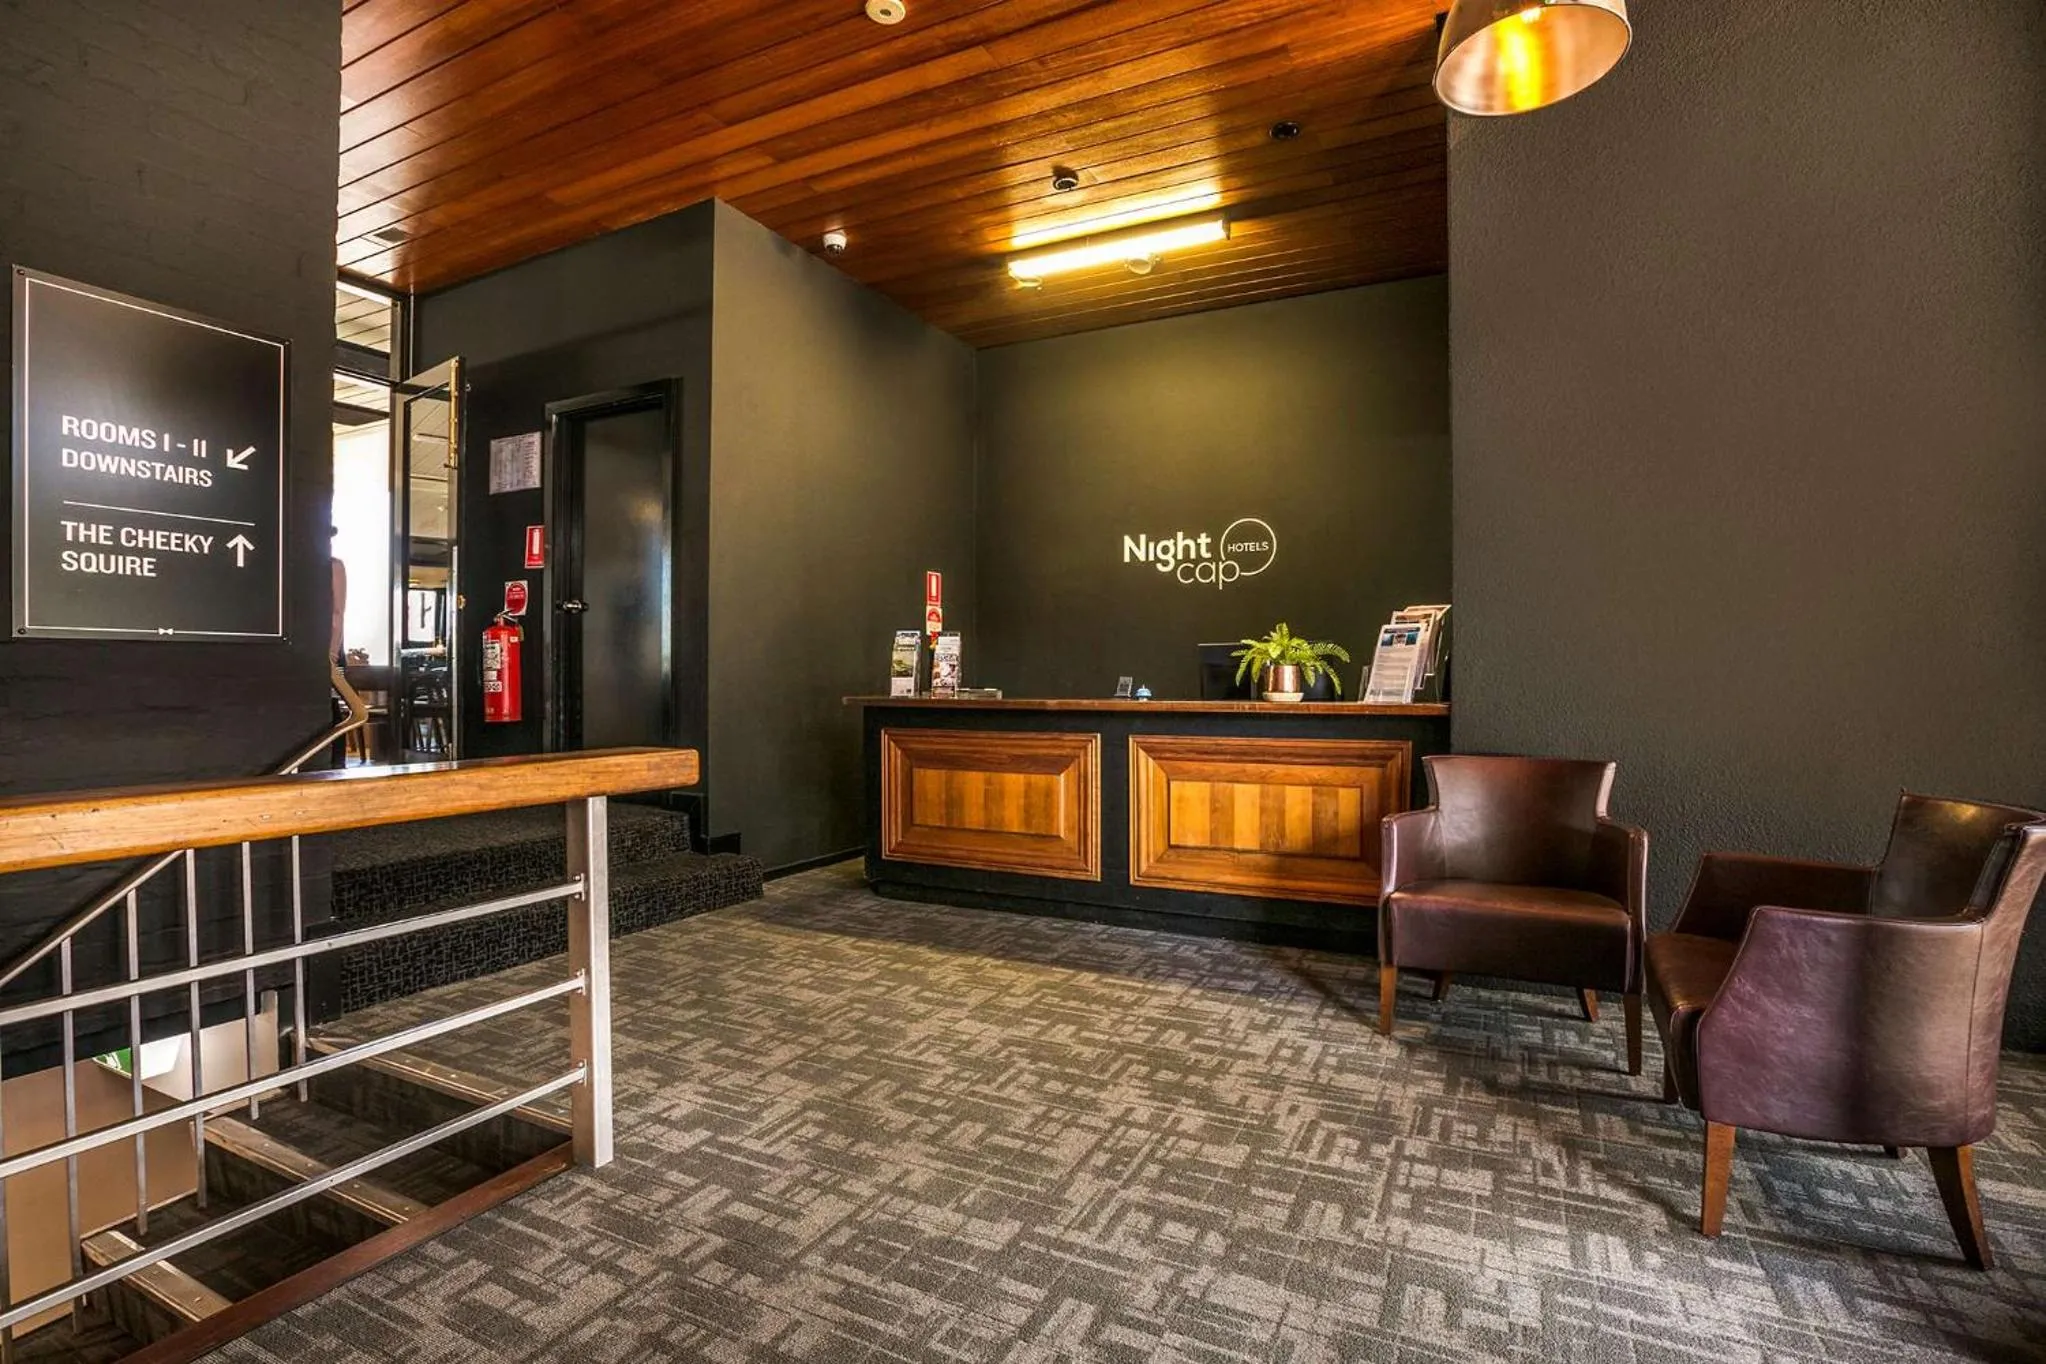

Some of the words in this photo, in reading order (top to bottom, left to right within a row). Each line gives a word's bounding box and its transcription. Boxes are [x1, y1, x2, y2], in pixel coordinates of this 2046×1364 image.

[62, 415, 157, 449] ROOMS
[62, 448, 213, 488] DOWNSTAIRS
[60, 520, 114, 545] THE
[120, 527, 214, 554] CHEEKY
[1123, 531, 1212, 572] Night
[1227, 541, 1269, 553] HOTELS
[61, 550, 157, 577] SQUIRE
[1177, 560, 1240, 590] cap
